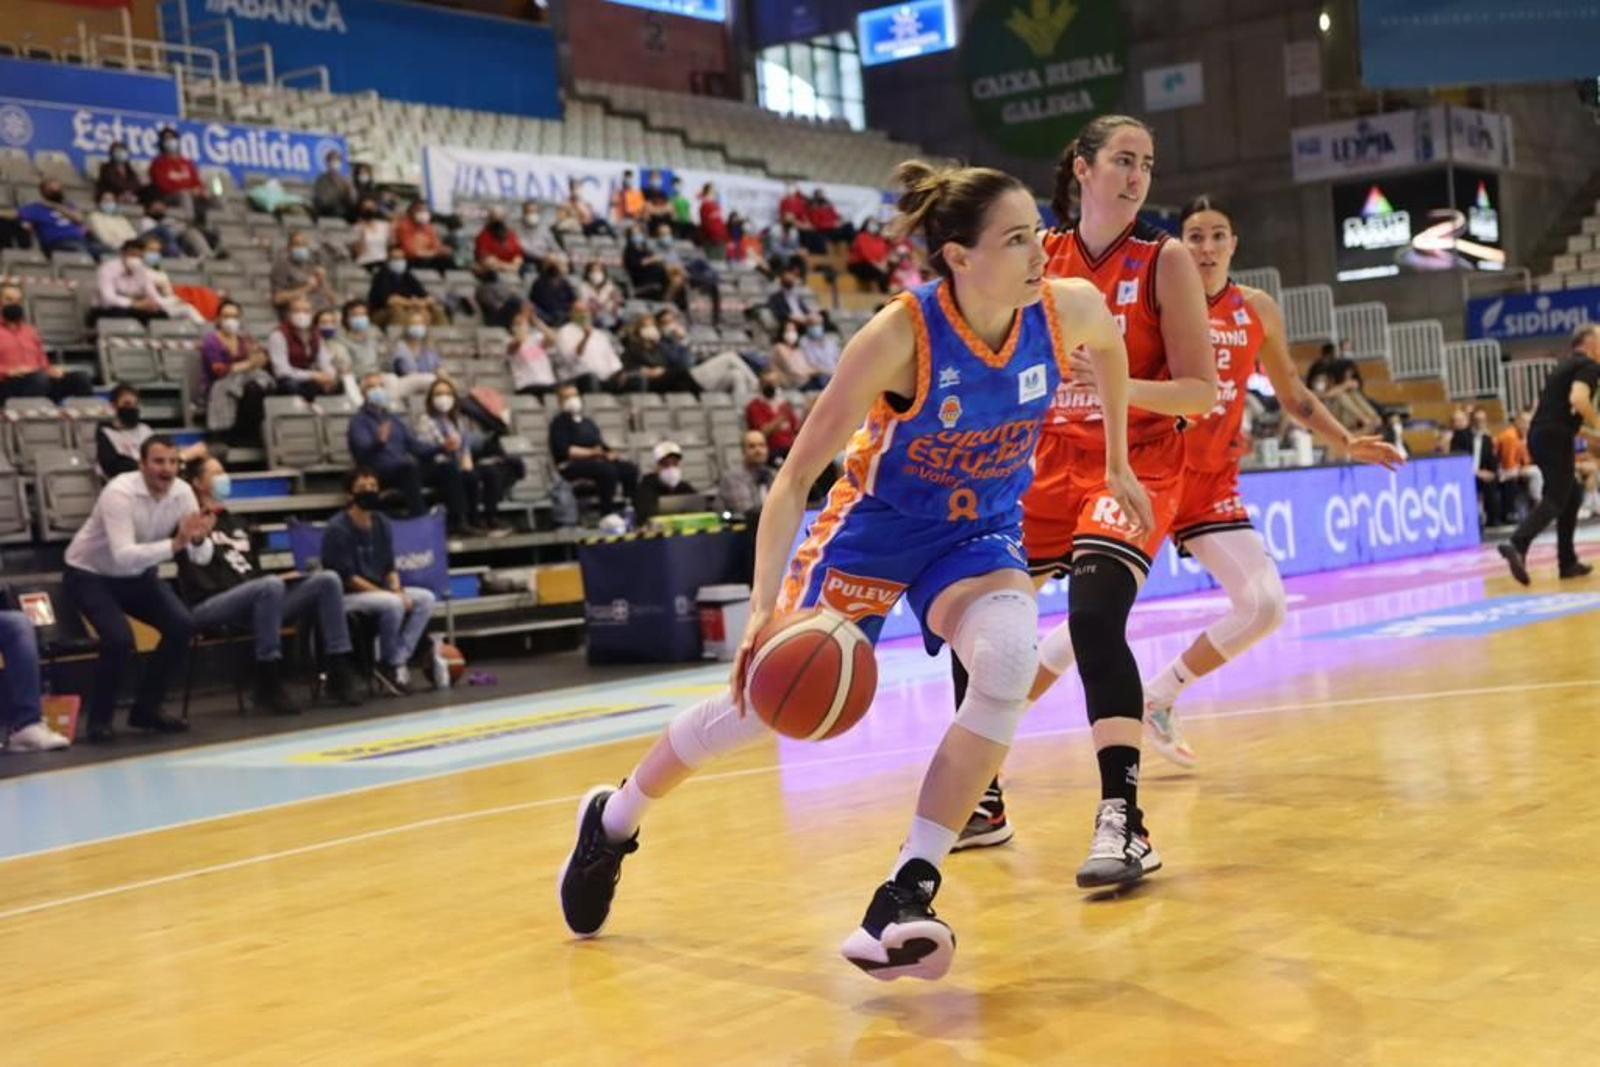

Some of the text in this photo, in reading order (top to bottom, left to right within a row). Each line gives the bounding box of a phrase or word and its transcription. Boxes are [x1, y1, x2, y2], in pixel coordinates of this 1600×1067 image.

[203, 122, 311, 171] Galicia
[947, 488, 978, 521] 8
[1325, 470, 1463, 552] endesa
